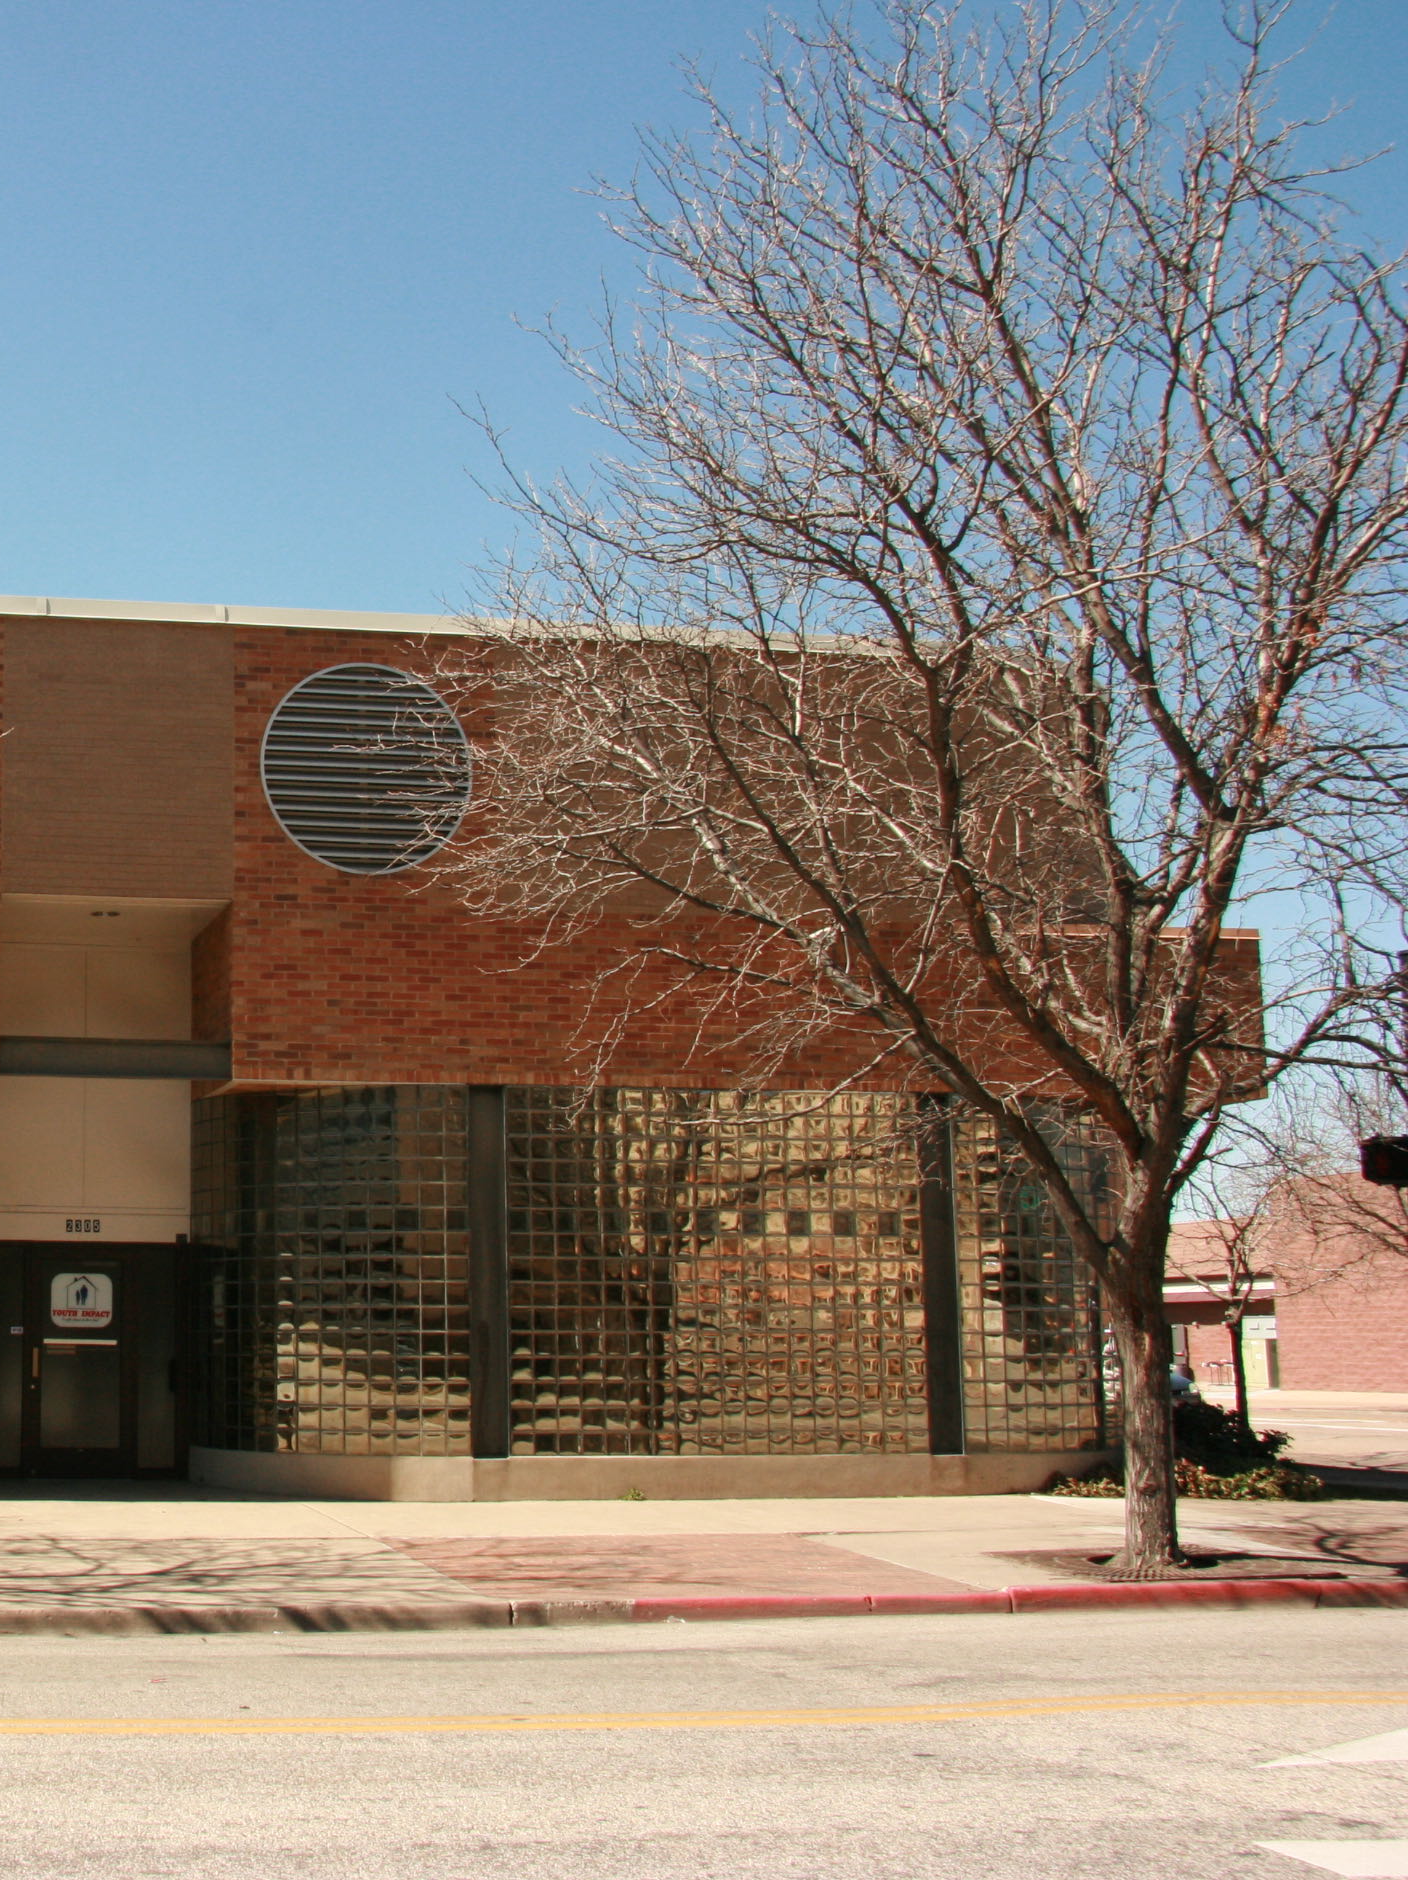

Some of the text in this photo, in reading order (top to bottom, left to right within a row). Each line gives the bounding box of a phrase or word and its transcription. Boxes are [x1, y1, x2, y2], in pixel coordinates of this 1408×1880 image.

[66, 1219, 100, 1232] 2305
[52, 1309, 111, 1318] YOUTH IMPACT
